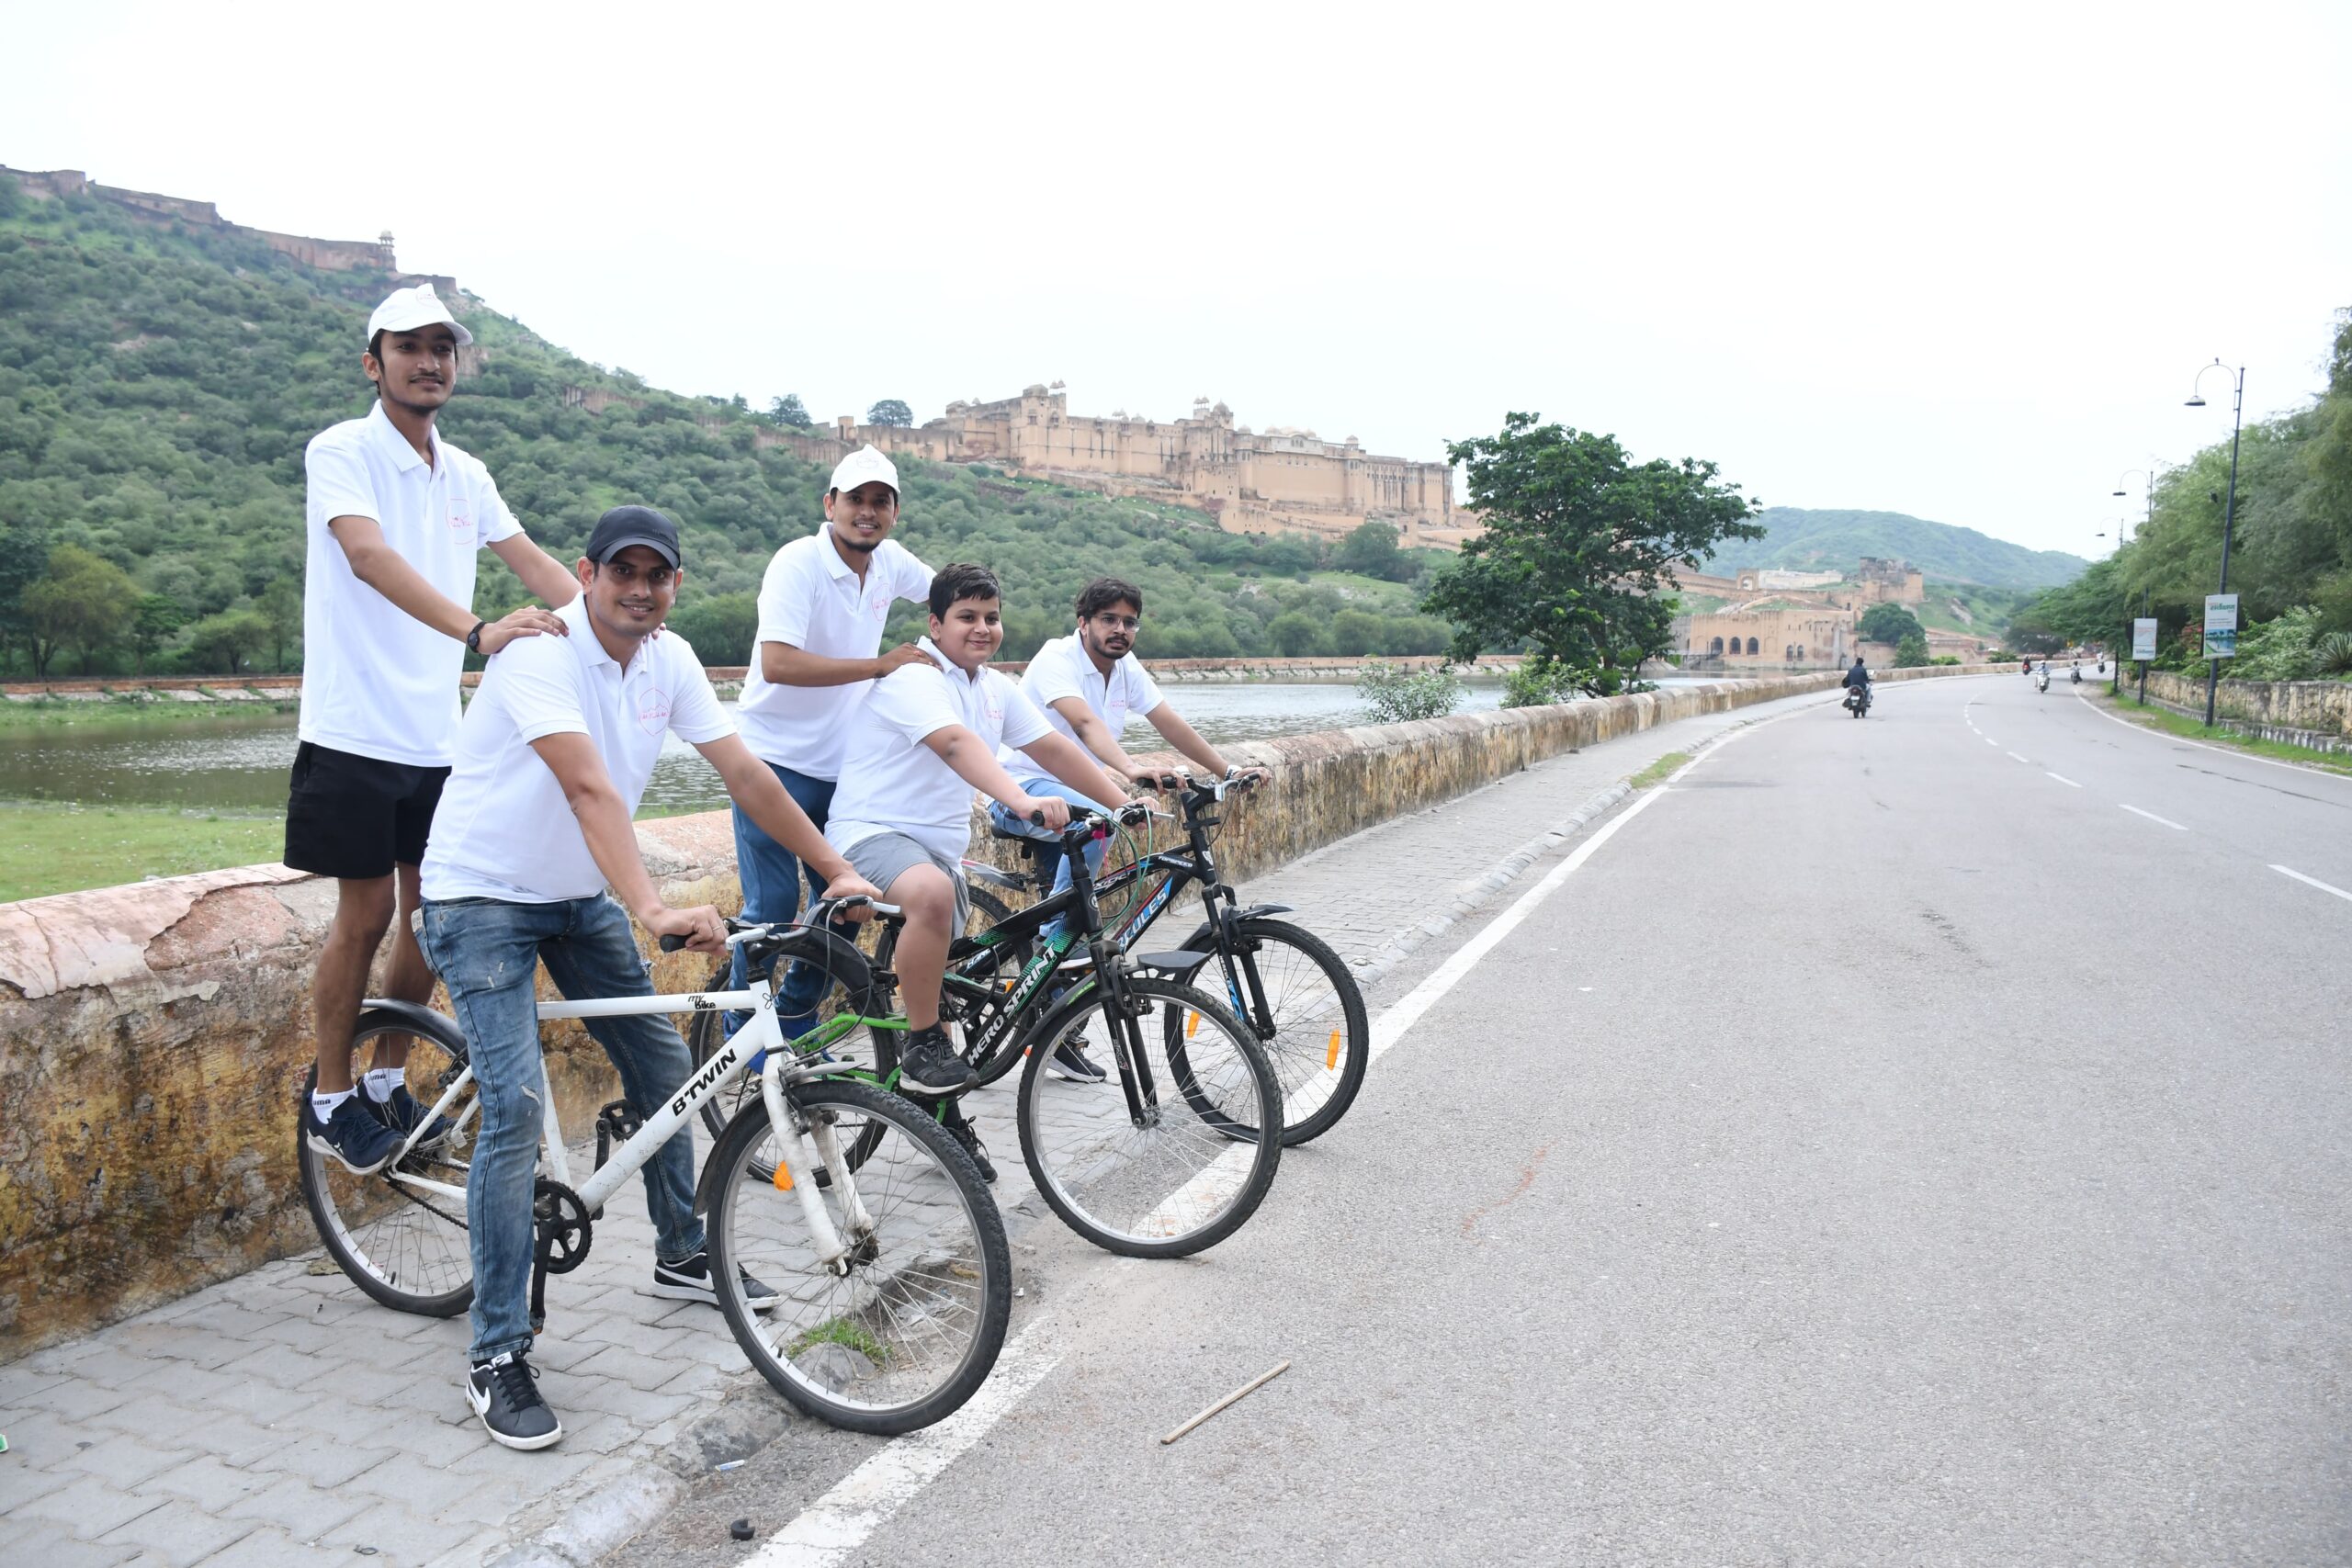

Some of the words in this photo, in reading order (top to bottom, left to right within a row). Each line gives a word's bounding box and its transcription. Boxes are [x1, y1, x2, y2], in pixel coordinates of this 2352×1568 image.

[1159, 855, 1193, 868] TOPSPEED
[1116, 887, 1167, 948] RCULES
[687, 995, 705, 1003] my
[695, 999, 717, 1010] bike
[967, 1016, 1004, 1066] HERO
[1003, 942, 1056, 1014] SPRINT
